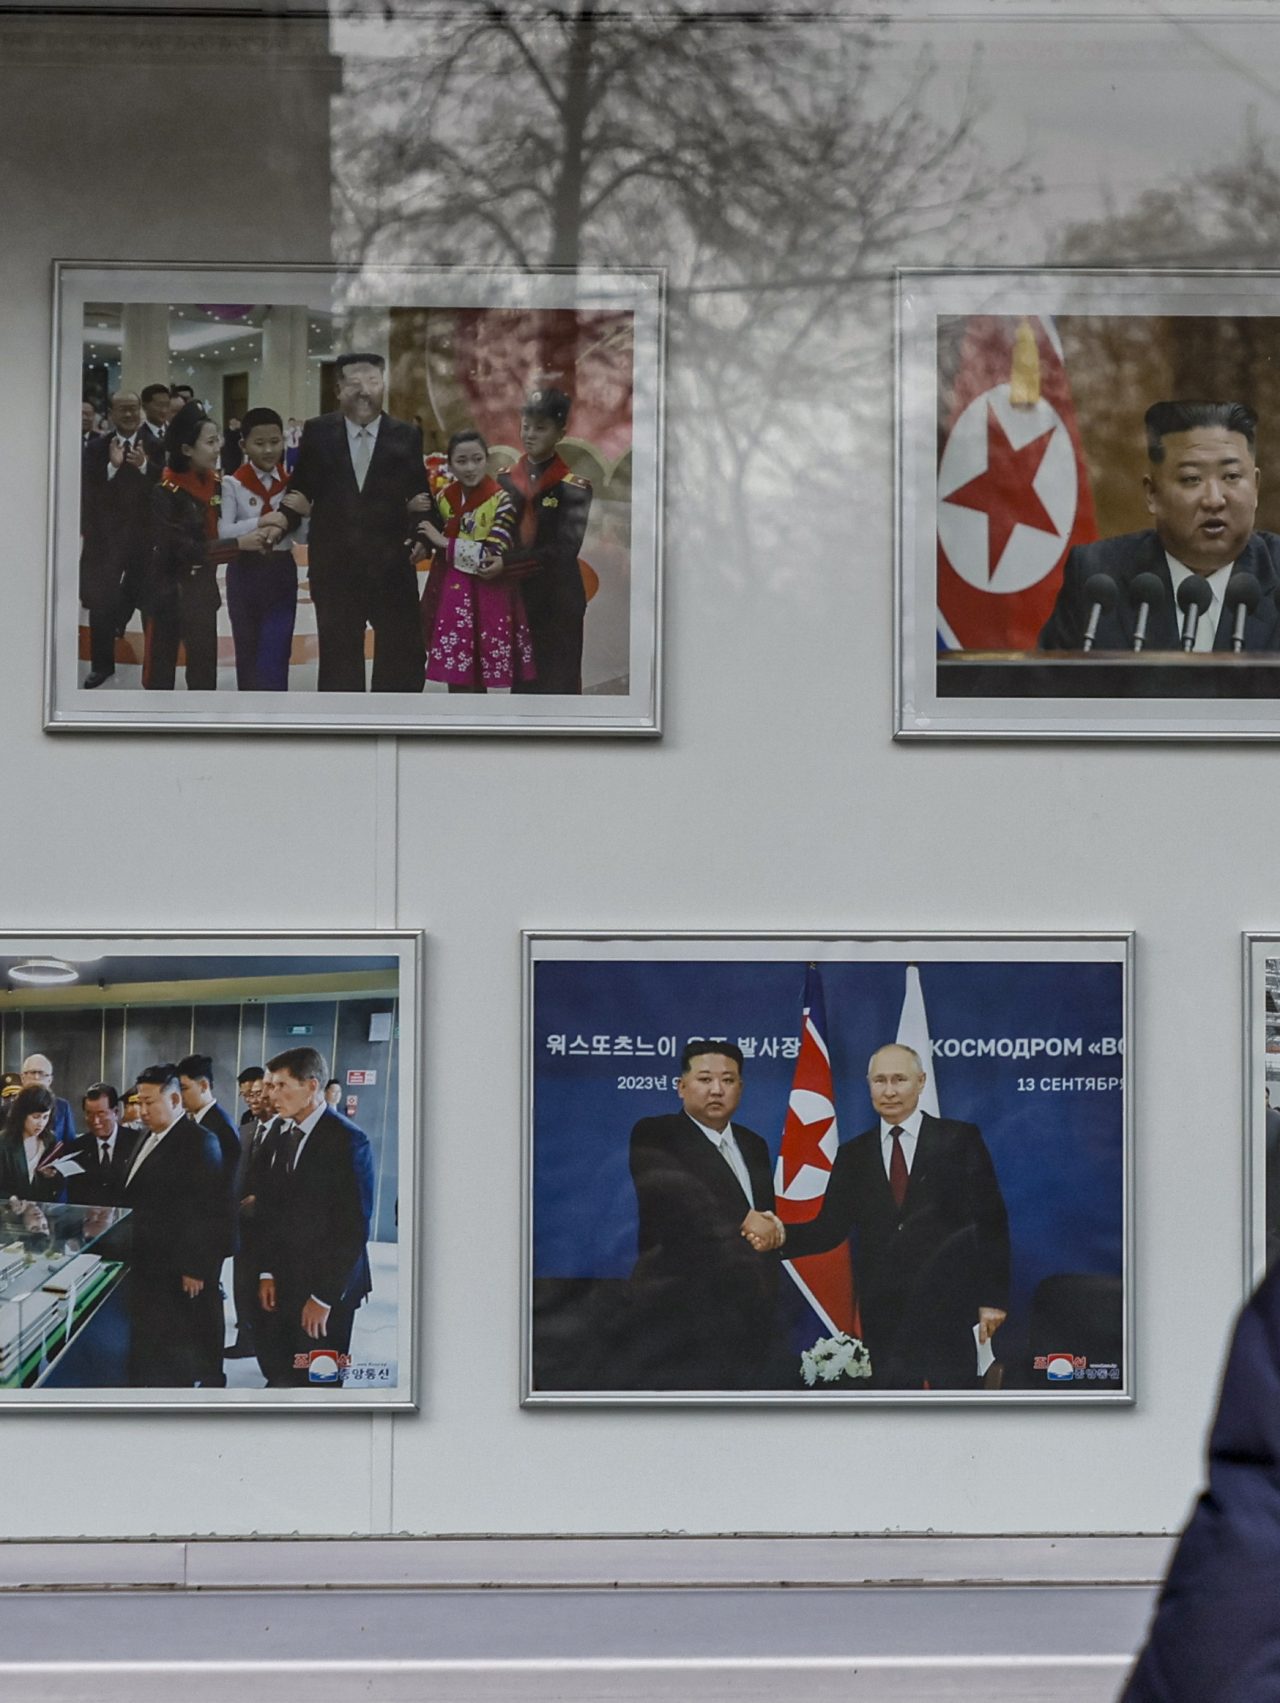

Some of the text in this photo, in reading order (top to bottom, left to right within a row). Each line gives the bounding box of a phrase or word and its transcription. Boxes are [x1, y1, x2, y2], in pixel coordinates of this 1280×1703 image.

[546, 1034, 802, 1058] 워스또츠느이 발사장
[931, 1038, 1083, 1059] КОСМОДРОМ
[617, 1075, 668, 1091] 2023년
[1017, 1078, 1035, 1091] 13
